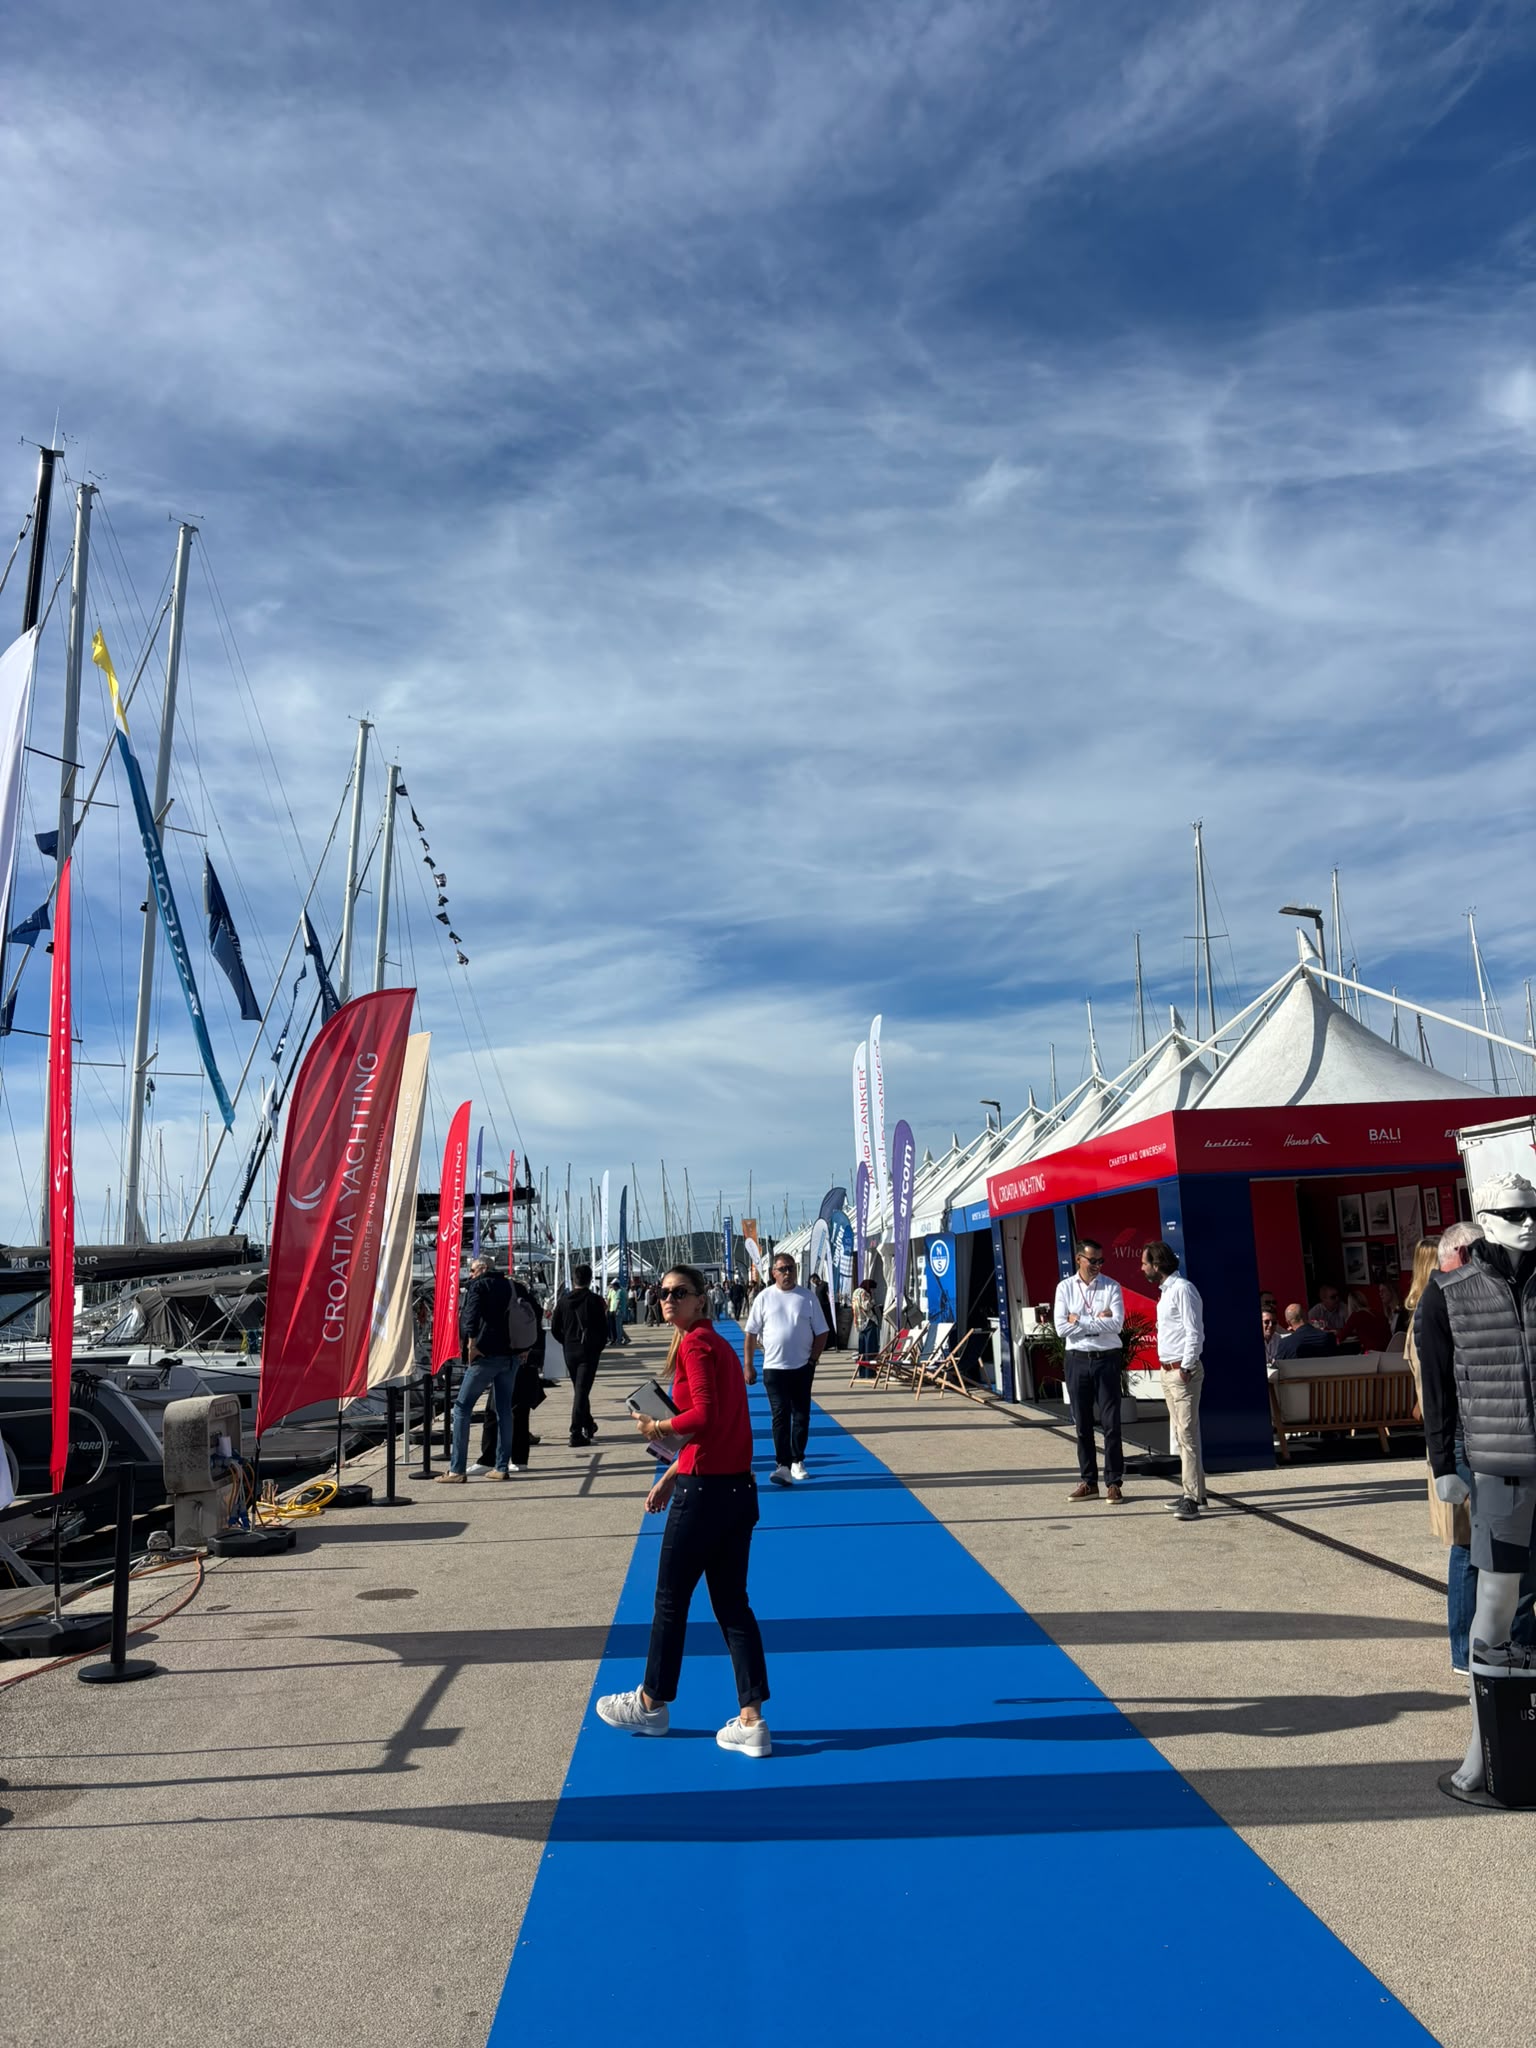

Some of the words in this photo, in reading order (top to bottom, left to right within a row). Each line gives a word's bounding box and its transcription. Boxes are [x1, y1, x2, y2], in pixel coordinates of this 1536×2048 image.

[339, 1052, 379, 1204] YACHTING
[1283, 1133, 1309, 1147] Hanse
[1369, 1128, 1401, 1142] BALI
[1444, 1129, 1459, 1138] FJO
[372, 1123, 385, 1187] OWNERSHIP
[1109, 1154, 1128, 1168] CHARTER
[1129, 1151, 1138, 1162] AND
[1139, 1142, 1166, 1159] OWNERSHIP
[1204, 1138, 1252, 1148] bellini
[451, 1142, 463, 1238] YACHTING
[999, 1182, 1019, 1203] CROATIA
[1018, 1172, 1046, 1197] YACHTING
[368, 1192, 377, 1215] AND
[362, 1217, 374, 1272] CHARTER
[1113, 1245, 1143, 1259] Whe
[322, 1213, 357, 1343] CROATIA
[447, 1243, 459, 1323] CROATIA
